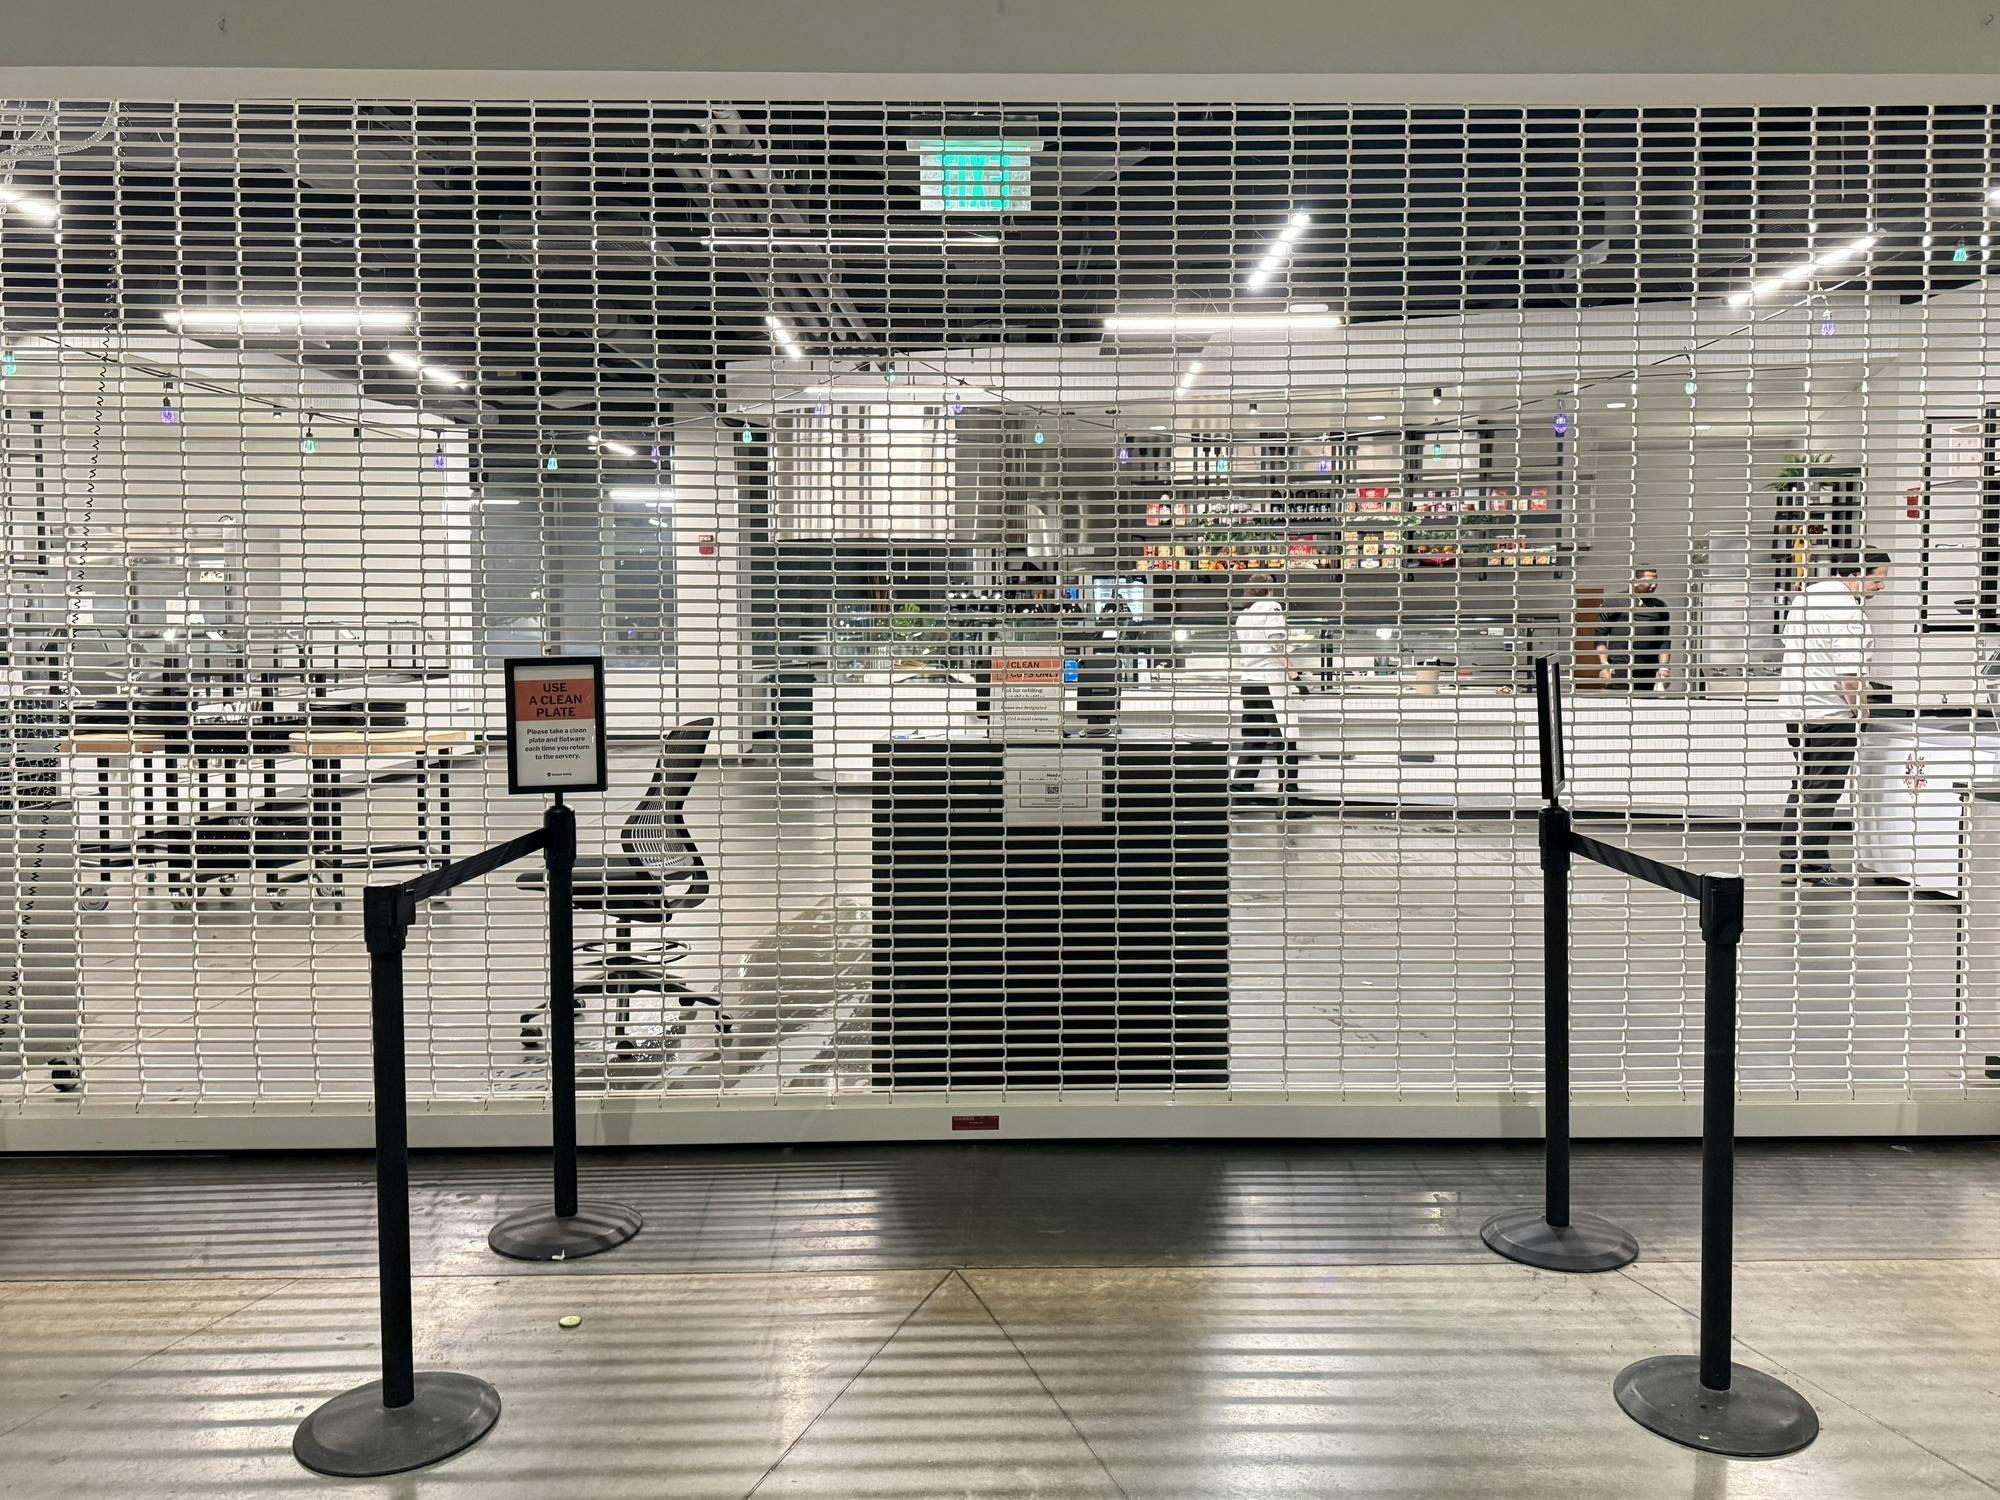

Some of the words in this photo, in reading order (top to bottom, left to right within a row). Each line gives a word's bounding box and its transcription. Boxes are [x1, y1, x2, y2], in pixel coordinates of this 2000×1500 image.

[542, 682, 568, 692] USE
[529, 696, 538, 706] A
[540, 694, 582, 705] CLEAN
[536, 706, 576, 718] PLATE
